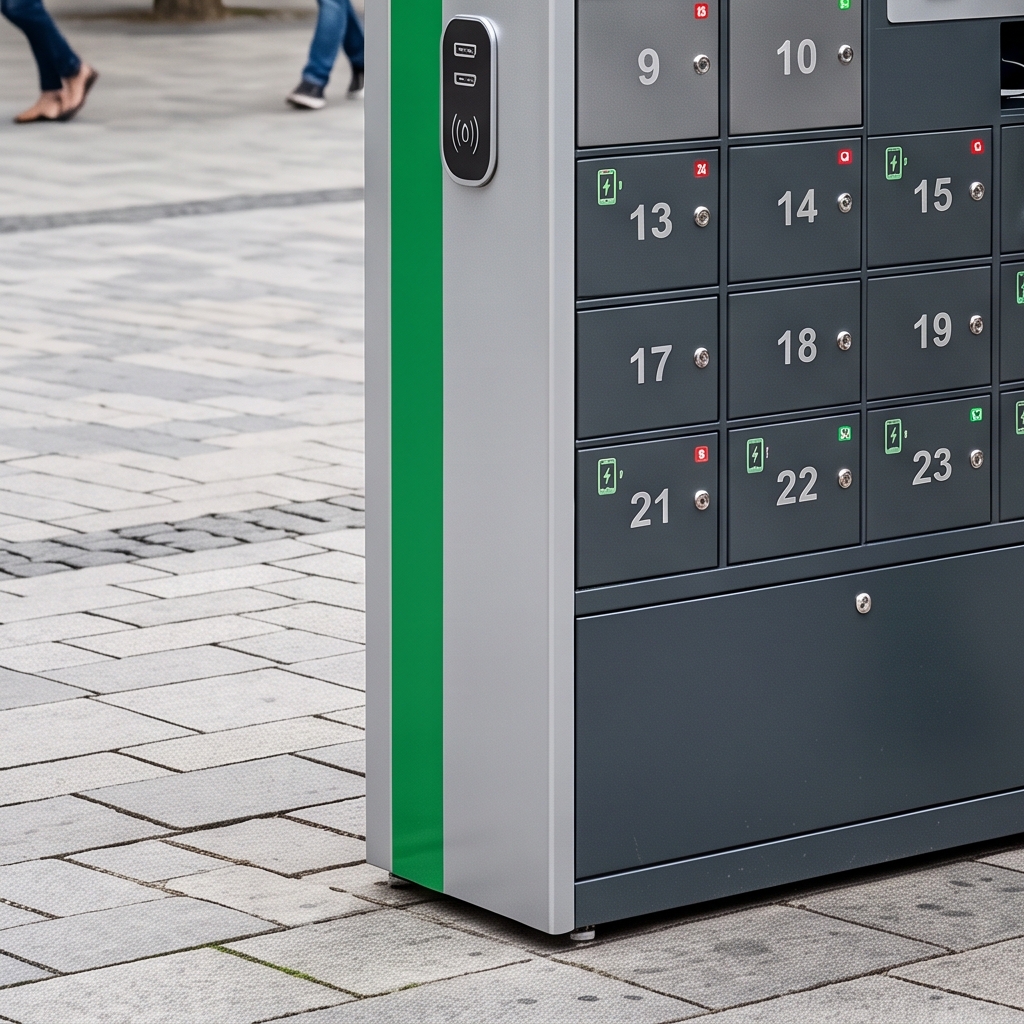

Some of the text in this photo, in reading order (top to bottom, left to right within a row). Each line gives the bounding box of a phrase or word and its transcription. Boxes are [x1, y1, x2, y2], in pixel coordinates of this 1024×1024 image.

[637, 48, 660, 86] 9
[776, 38, 817, 76] 10
[777, 188, 818, 226] 14
[914, 177, 953, 214] 15
[630, 202, 673, 241] 13
[777, 327, 817, 365] 18
[913, 311, 952, 349] 19
[630, 344, 673, 384] 17
[912, 447, 952, 486] 23
[776, 466, 818, 507] 22
[630, 488, 672, 529] 21
